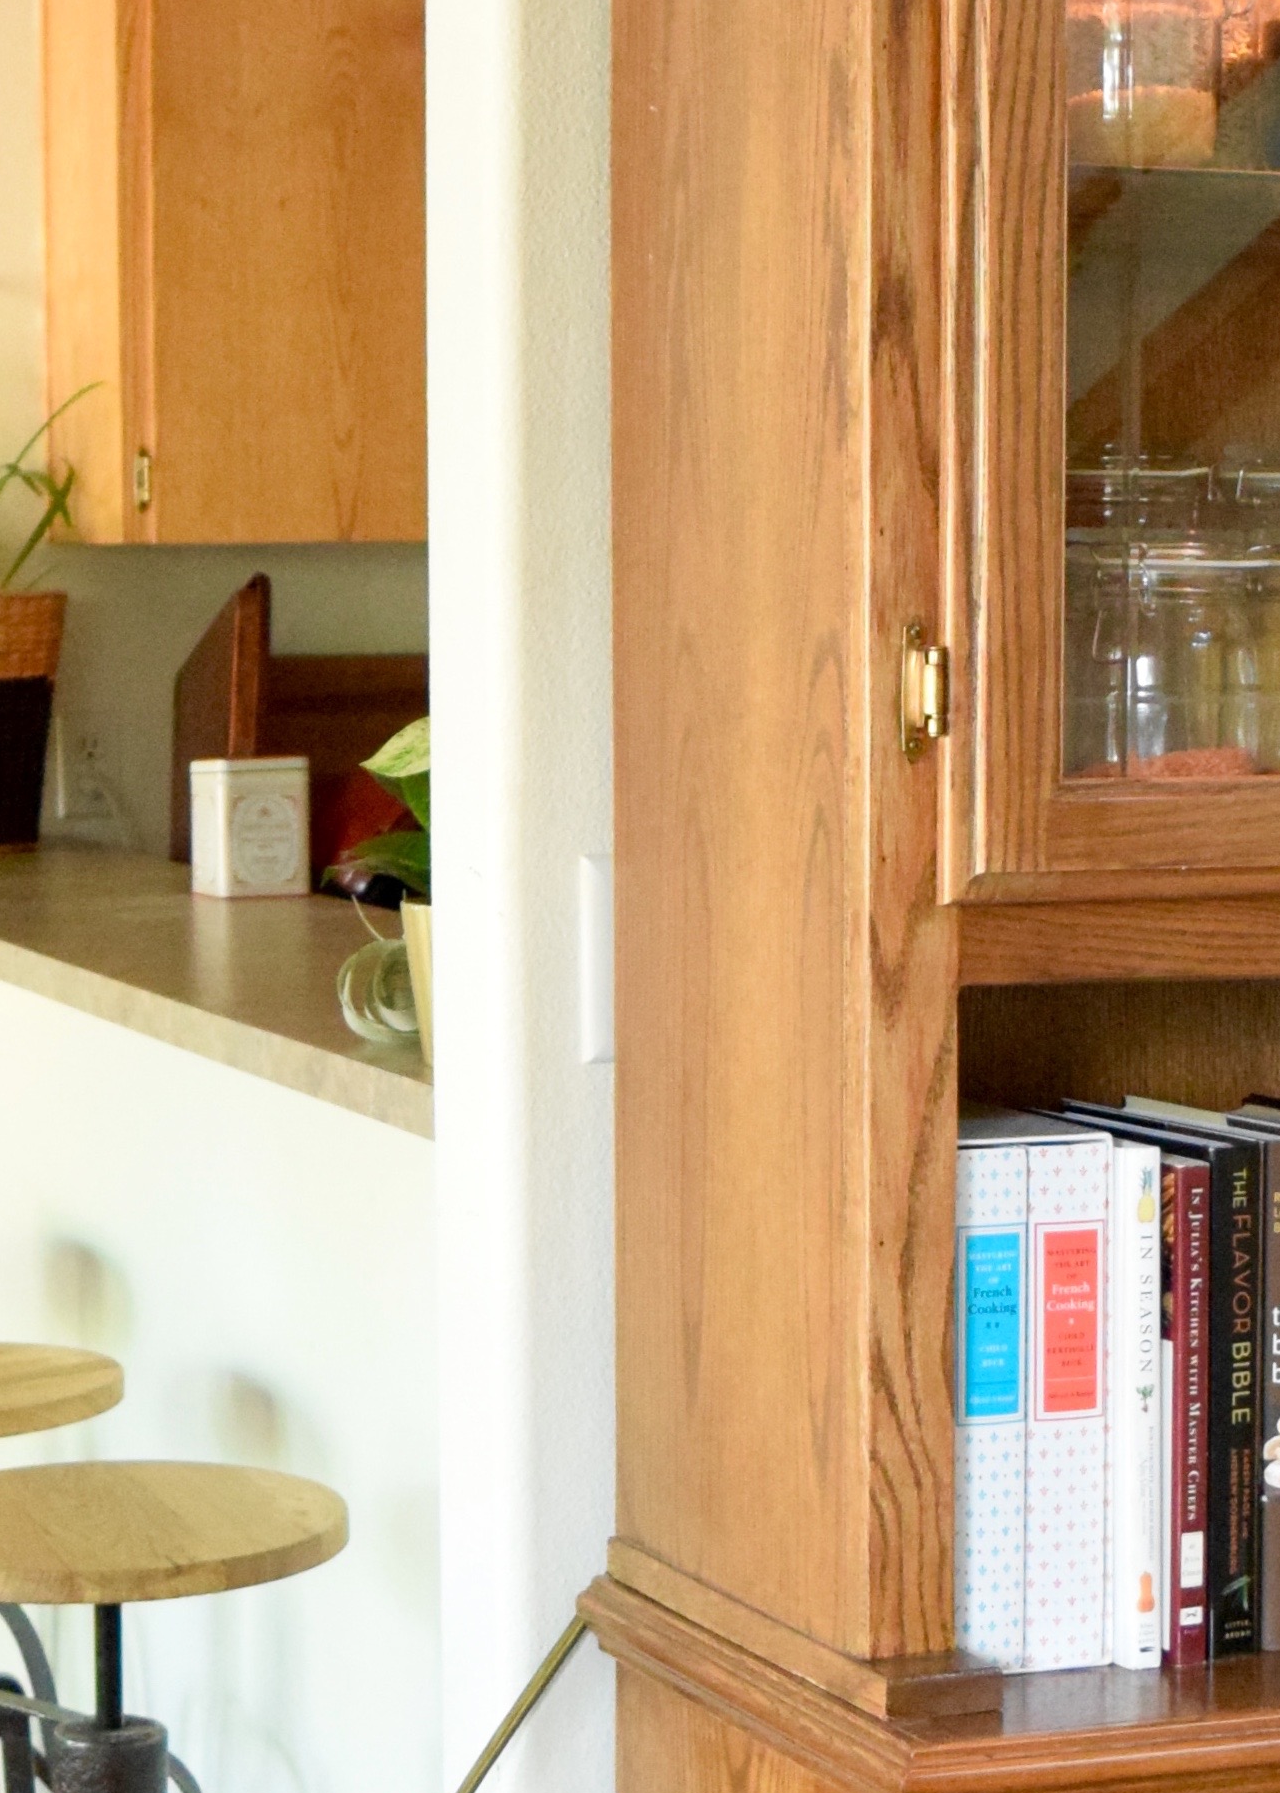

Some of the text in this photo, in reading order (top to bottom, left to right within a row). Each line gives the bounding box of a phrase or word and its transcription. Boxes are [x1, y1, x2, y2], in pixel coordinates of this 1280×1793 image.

[973, 1285, 1012, 1298] French
[1052, 1281, 1090, 1295] French
[1139, 1234, 1154, 1372] IN SEASON
[1231, 1168, 1252, 1424] THE FLAVOR BIBLE
[968, 1302, 1017, 1315] Cooking
[1046, 1298, 1095, 1312] Cooking
